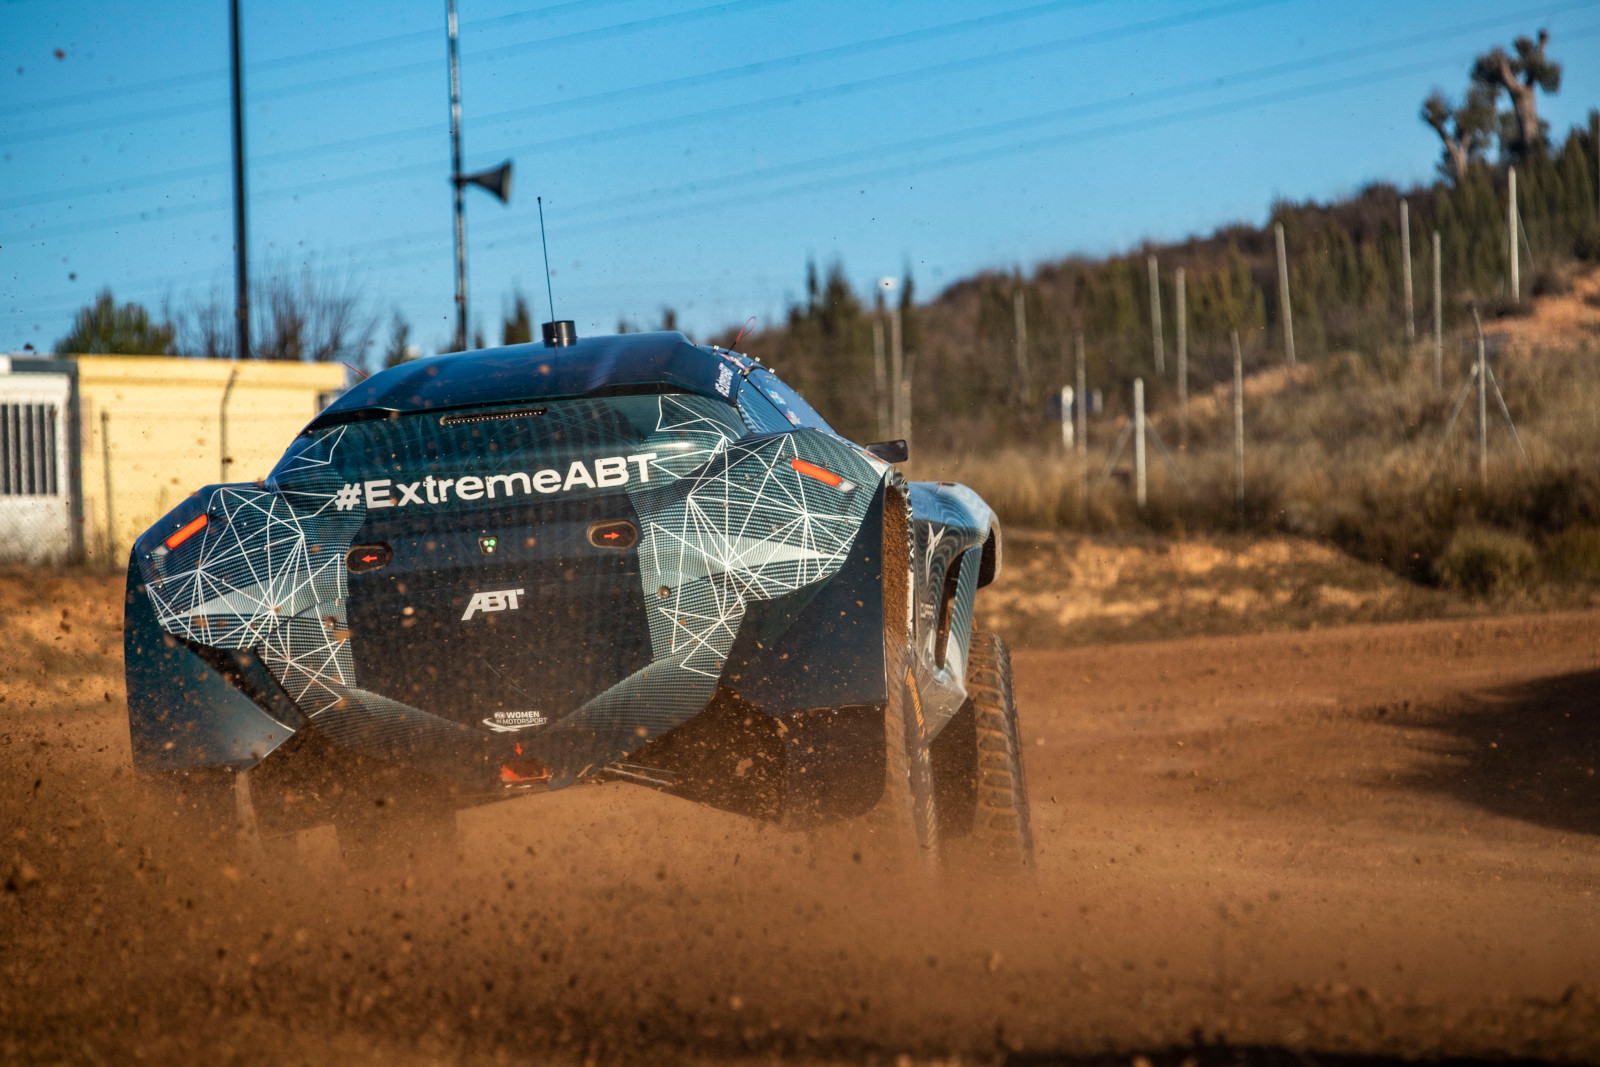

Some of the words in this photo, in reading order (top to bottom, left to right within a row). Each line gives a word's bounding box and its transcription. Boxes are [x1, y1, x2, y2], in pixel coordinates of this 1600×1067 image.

[334, 453, 657, 511] #ExtremeABT
[461, 588, 524, 621] ABT
[502, 717, 548, 725] MOTORSPORT
